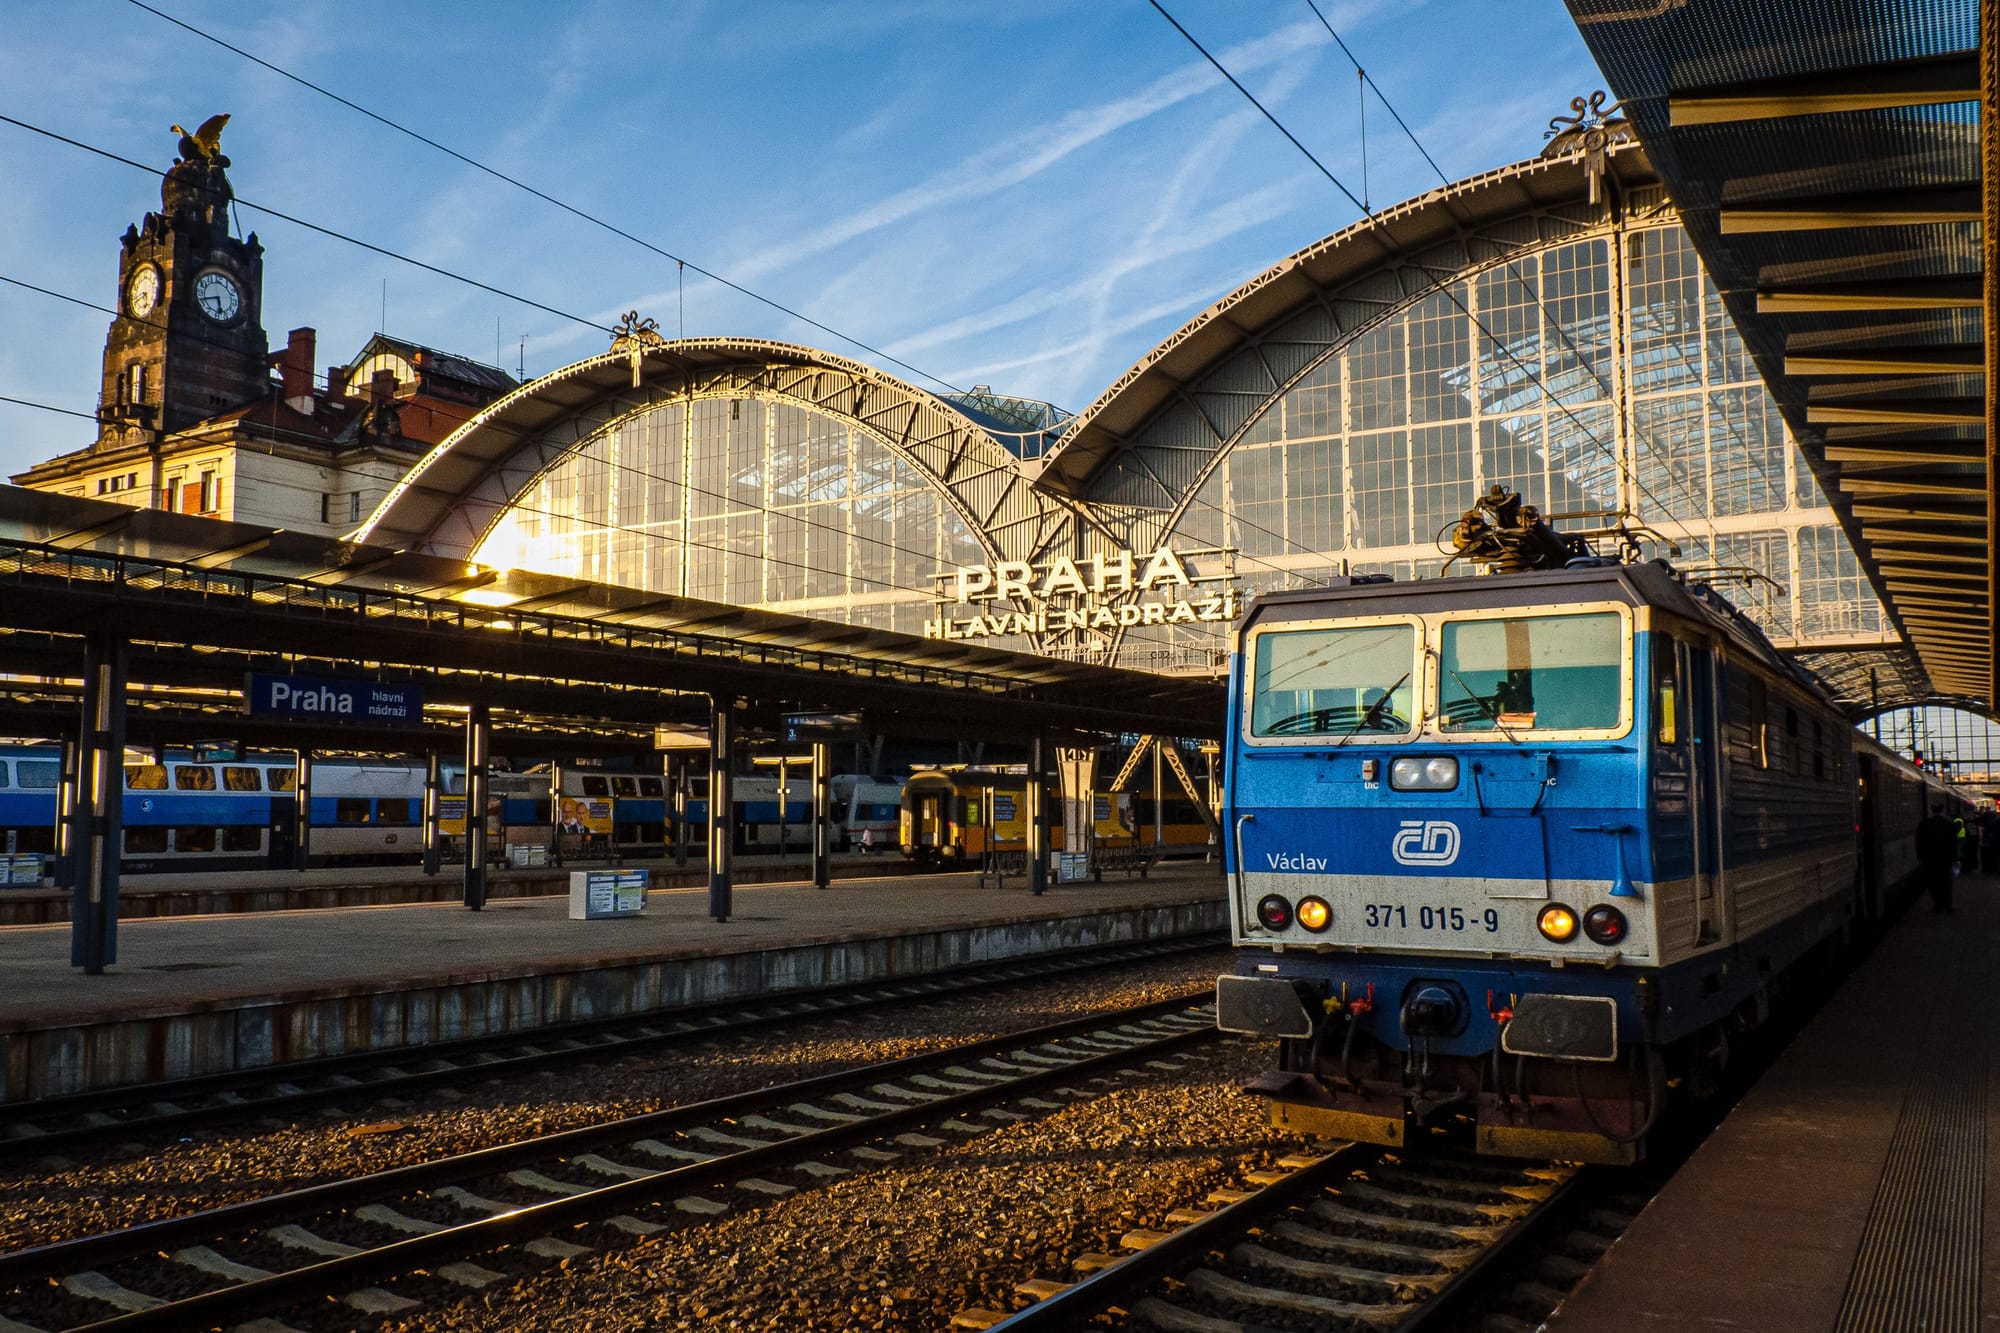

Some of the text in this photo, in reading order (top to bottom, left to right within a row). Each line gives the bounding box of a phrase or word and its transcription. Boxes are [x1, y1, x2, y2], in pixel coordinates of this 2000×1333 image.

[957, 547, 1190, 604] PRAHA
[924, 588, 1235, 639] HLAVNÍ NÁDRAŽÍ
[271, 682, 352, 713] Praha
[372, 690, 404, 703] hlavní
[368, 705, 407, 717] nádraží
[1364, 782, 1379, 790] UIC
[1266, 853, 1328, 870] Václav
[1366, 904, 1407, 928] 371
